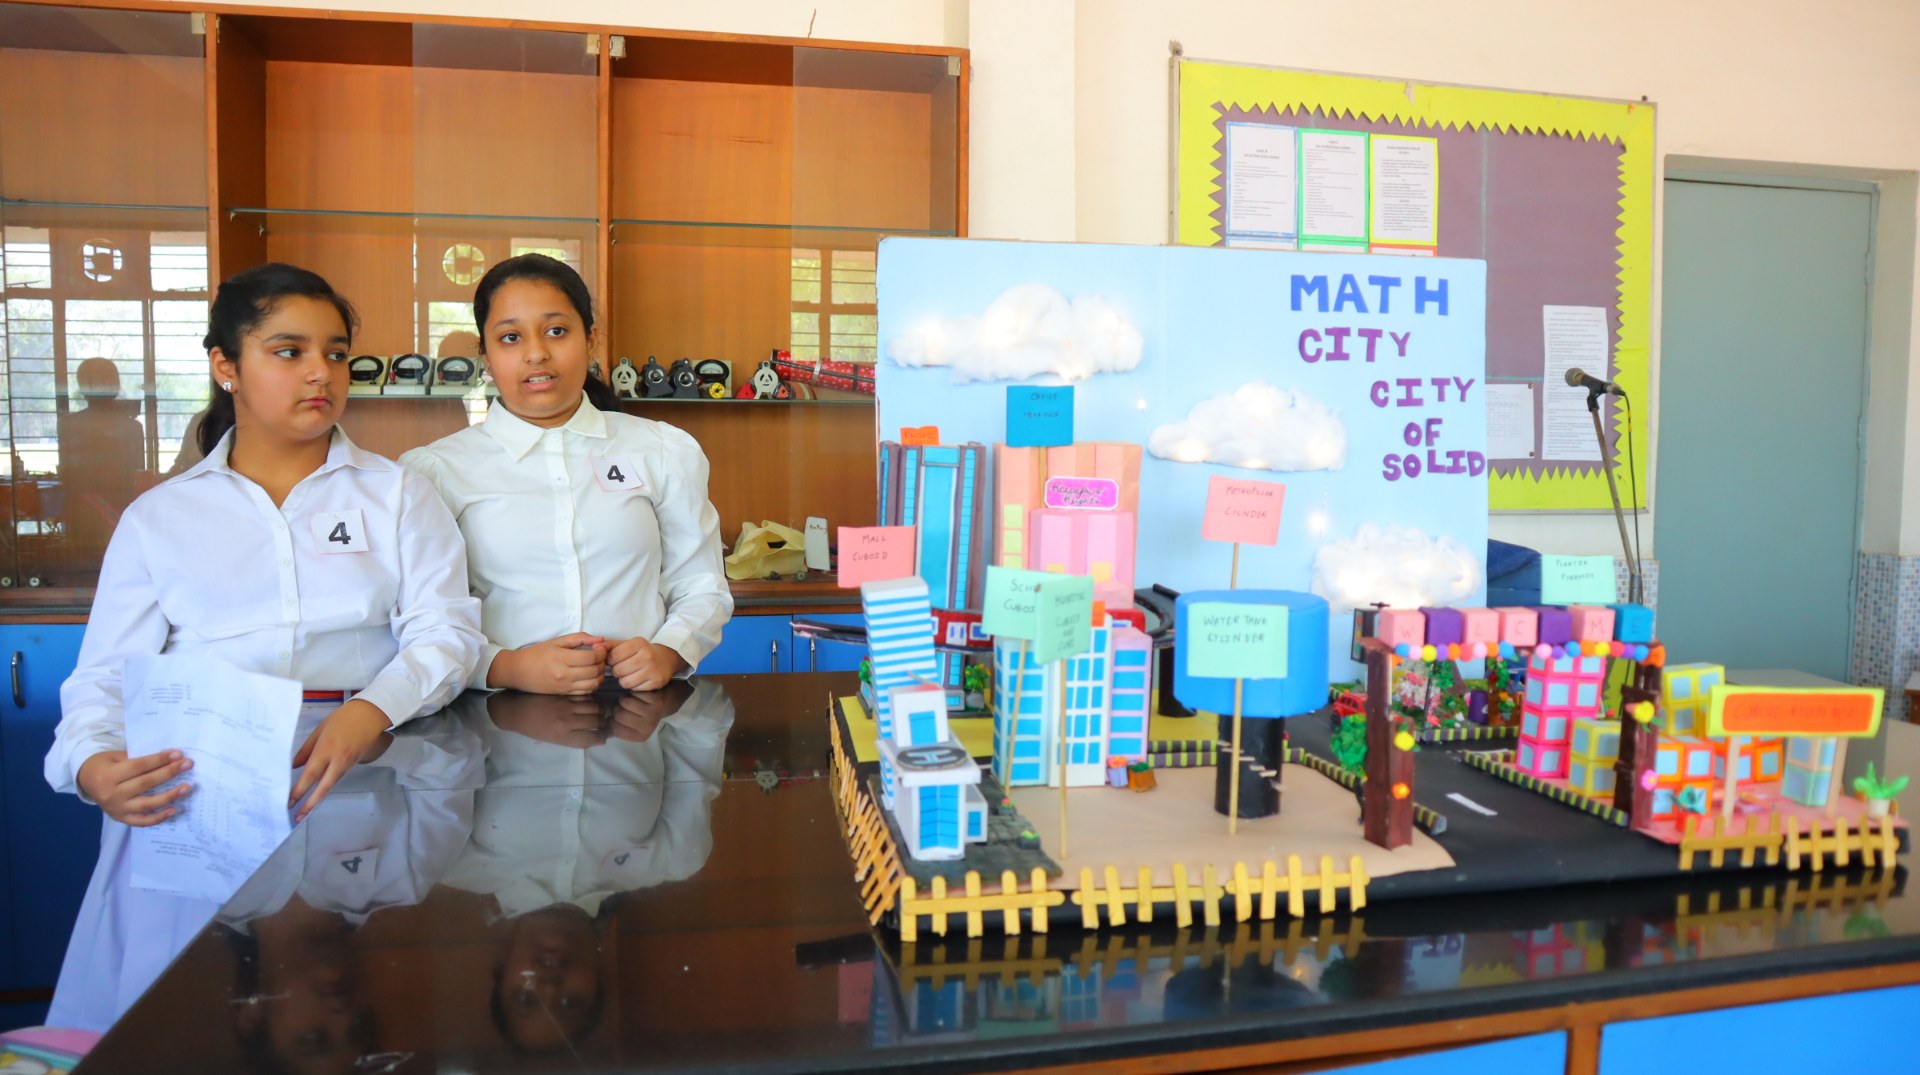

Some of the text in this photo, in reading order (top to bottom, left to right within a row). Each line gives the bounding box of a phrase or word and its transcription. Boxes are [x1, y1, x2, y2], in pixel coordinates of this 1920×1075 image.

[1291, 274, 1448, 316] MATH
[1299, 327, 1411, 363] CITY
[1370, 376, 1475, 408] CITY
[1404, 418, 1443, 447] OF
[607, 465, 625, 483] 4
[1382, 449, 1486, 482] SOLID
[328, 521, 351, 544] 4
[862, 534, 888, 544] MALL
[853, 552, 888, 561] CUBOID
[1011, 578, 1034, 592] SCH
[1003, 599, 1036, 613] CUBOI
[1203, 614, 1268, 626] WATER TANK
